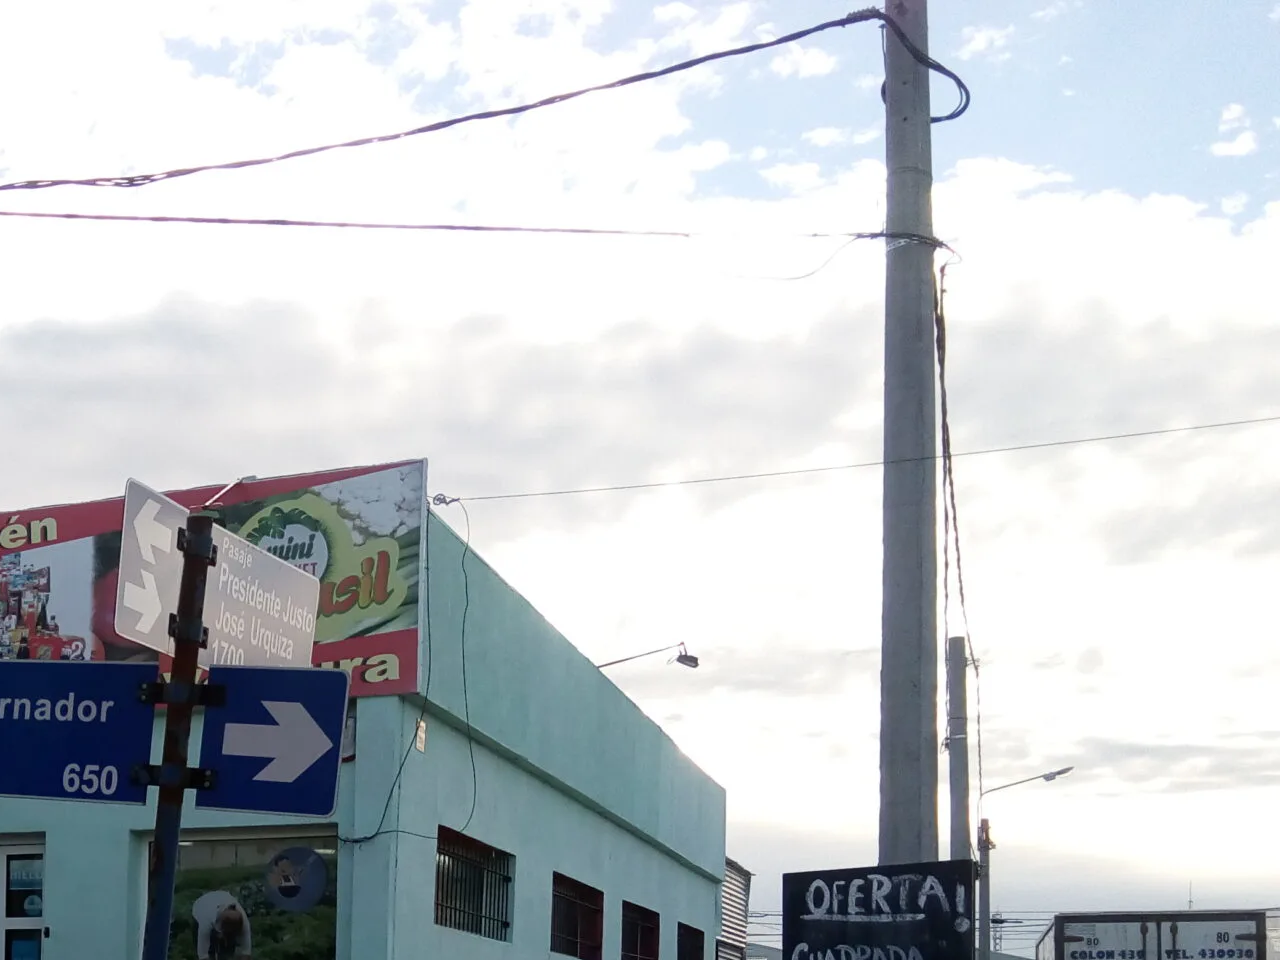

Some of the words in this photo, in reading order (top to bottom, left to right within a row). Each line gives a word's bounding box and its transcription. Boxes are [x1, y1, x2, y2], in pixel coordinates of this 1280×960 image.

[222, 537, 253, 569] Pasaje
[218, 562, 281, 618] Presidente
[282, 596, 314, 633] Justo
[215, 601, 245, 640] José
[250, 615, 294, 661] Urquiza
[61, 763, 118, 796] 650
[1086, 938, 1099, 946] 80
[1216, 932, 1230, 943] 80
[1070, 950, 1115, 960] COLON
